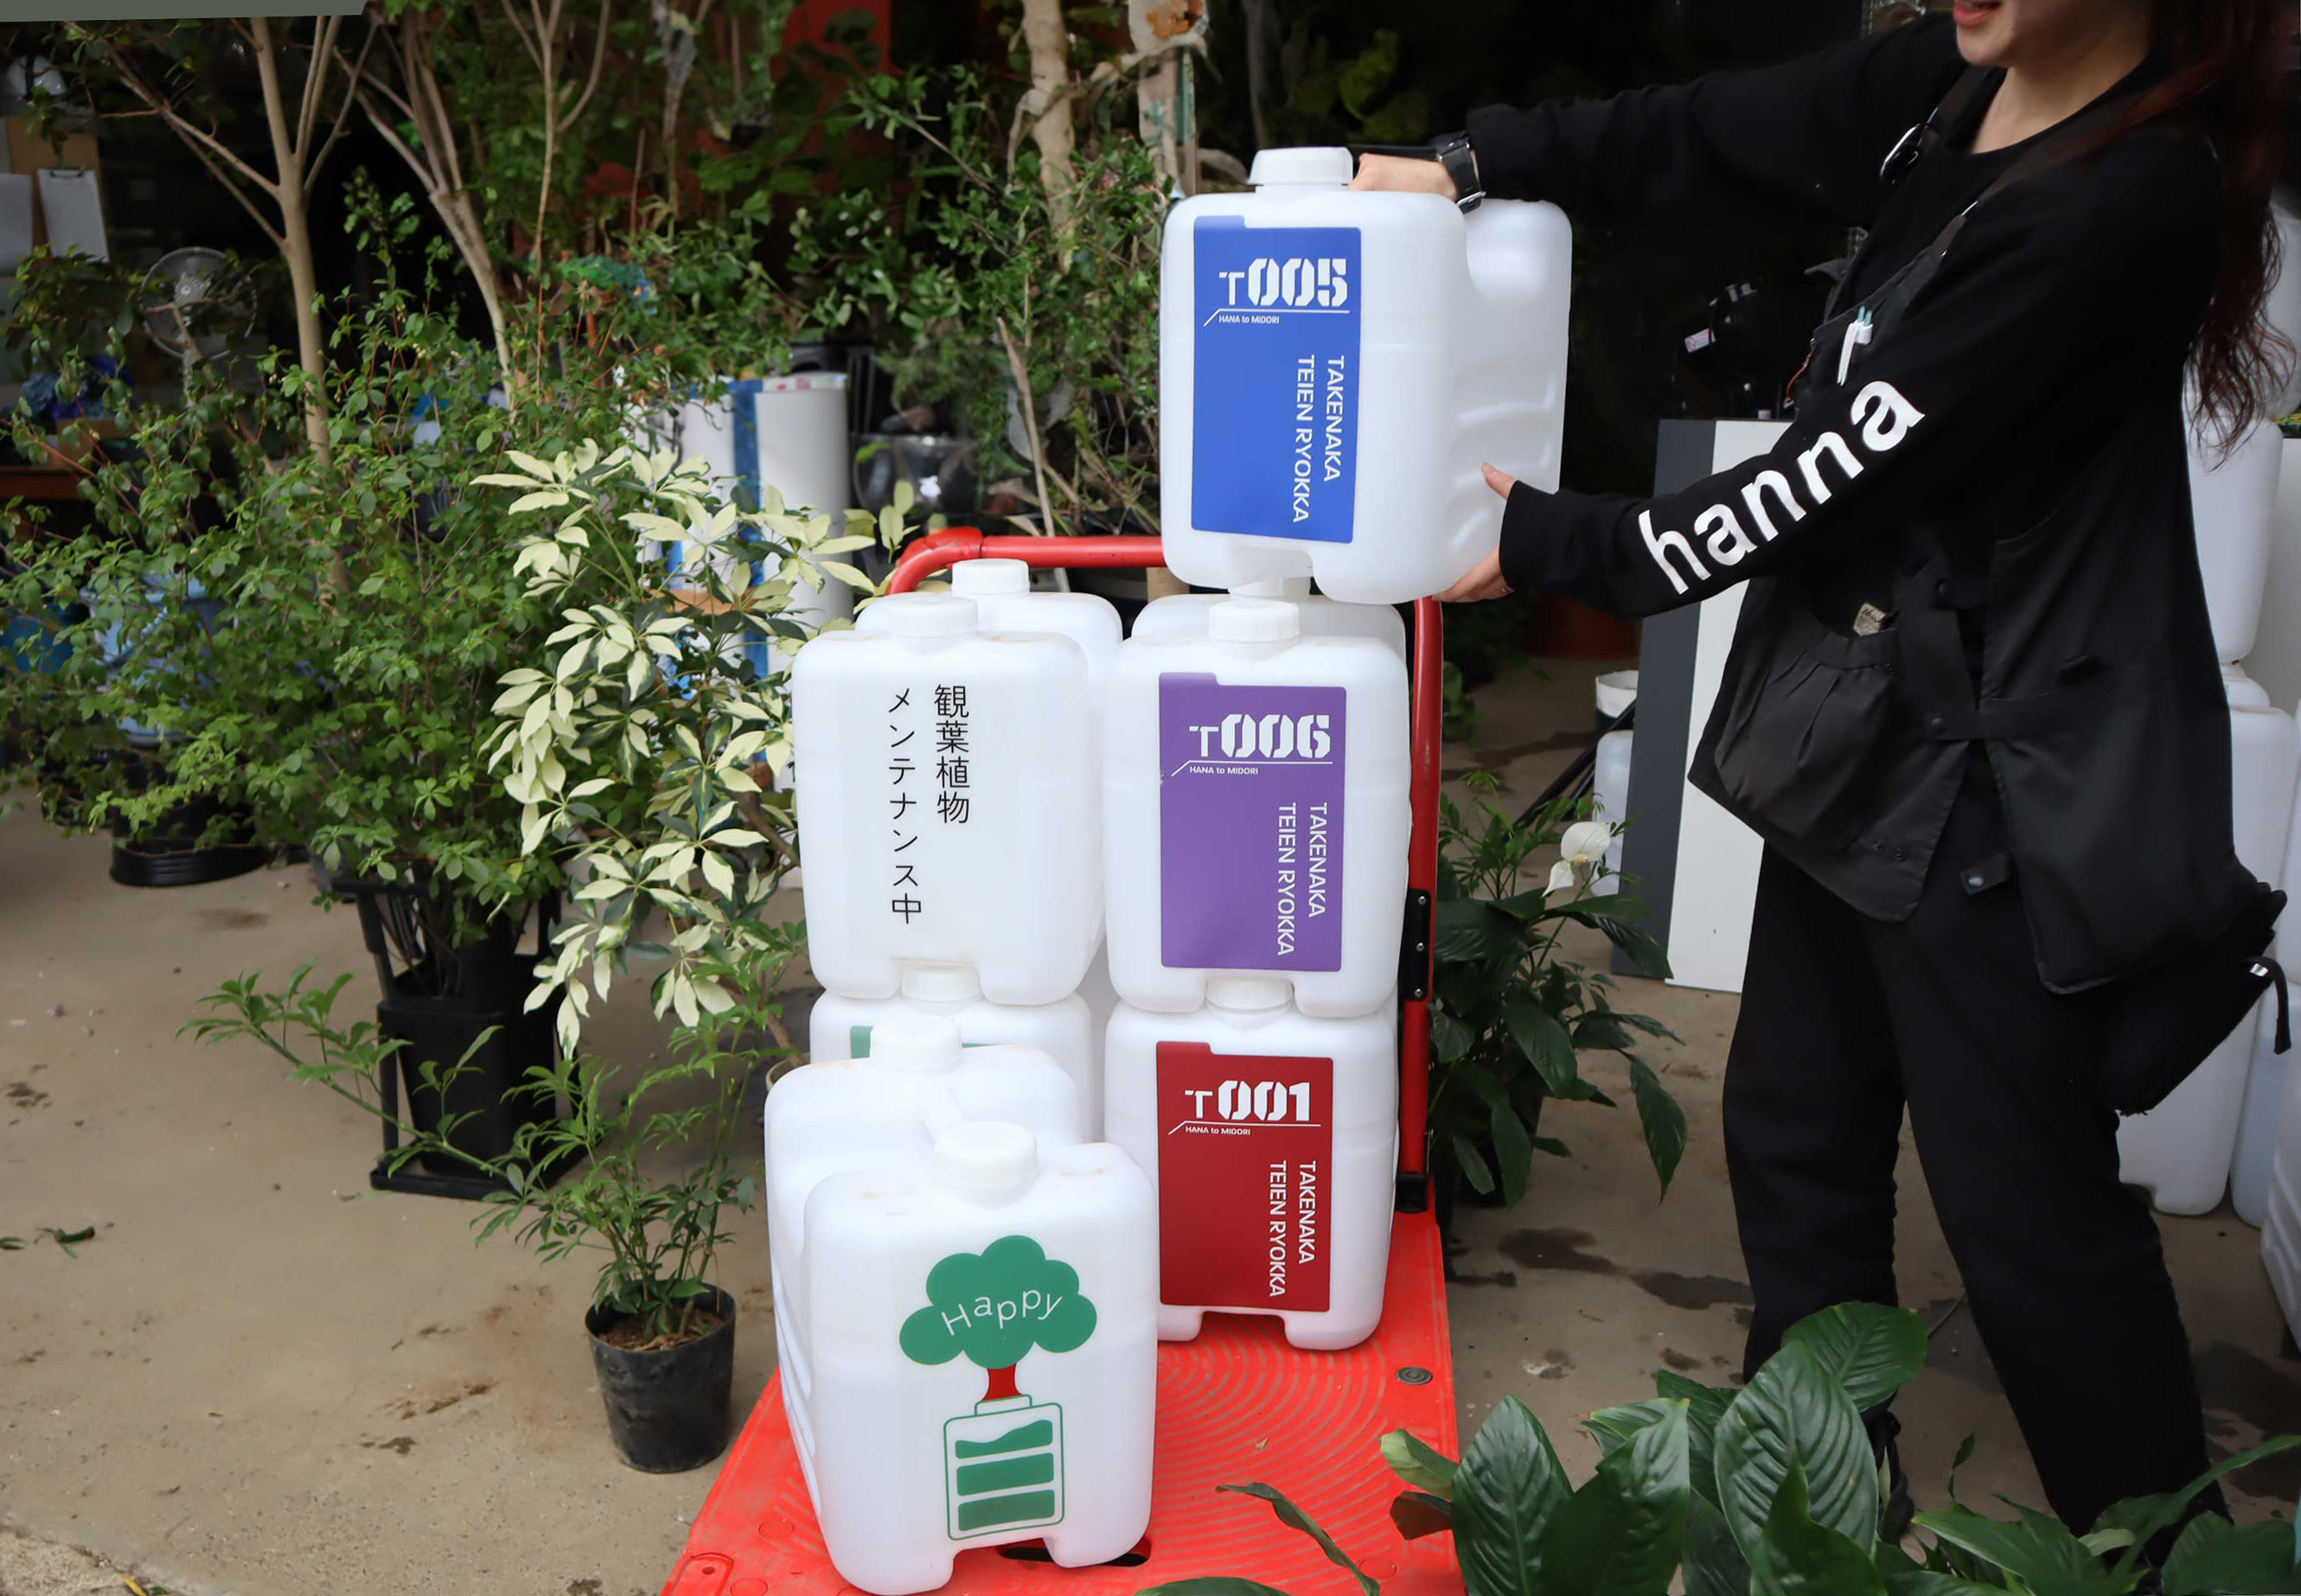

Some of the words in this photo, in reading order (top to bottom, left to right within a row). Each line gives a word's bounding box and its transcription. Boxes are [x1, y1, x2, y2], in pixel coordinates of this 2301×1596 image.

[1218, 258, 1348, 306] T005
[1218, 314, 1241, 323] HANA
[1241, 315, 1250, 323] to
[1251, 315, 1280, 325] MIDORI
[1296, 354, 1315, 422] TEIEN
[1323, 354, 1345, 482] TAKENAKA
[1293, 427, 1313, 523] RYOKKA
[1638, 380, 1926, 595] hanna
[934, 683, 970, 824] 観葉植物
[1188, 713, 1331, 759] T006
[1189, 766, 1214, 775] HANA
[1227, 767, 1258, 776] MIDORI
[888, 687, 922, 924] メンテナンス中
[1278, 801, 1296, 864] TEIEN
[1308, 801, 1327, 918] TAKENAKA
[1277, 869, 1295, 956] RYOKKA
[1185, 1080, 1310, 1121] T001
[1186, 1126, 1209, 1134] HANA
[1211, 1127, 1219, 1135] to
[1221, 1127, 1250, 1136] MIDORI
[1269, 1159, 1287, 1216] TEIEN
[1299, 1160, 1316, 1264] TAKENAKA
[1269, 1220, 1287, 1297] RYOKKA
[941, 1289, 1064, 1337] Happy
